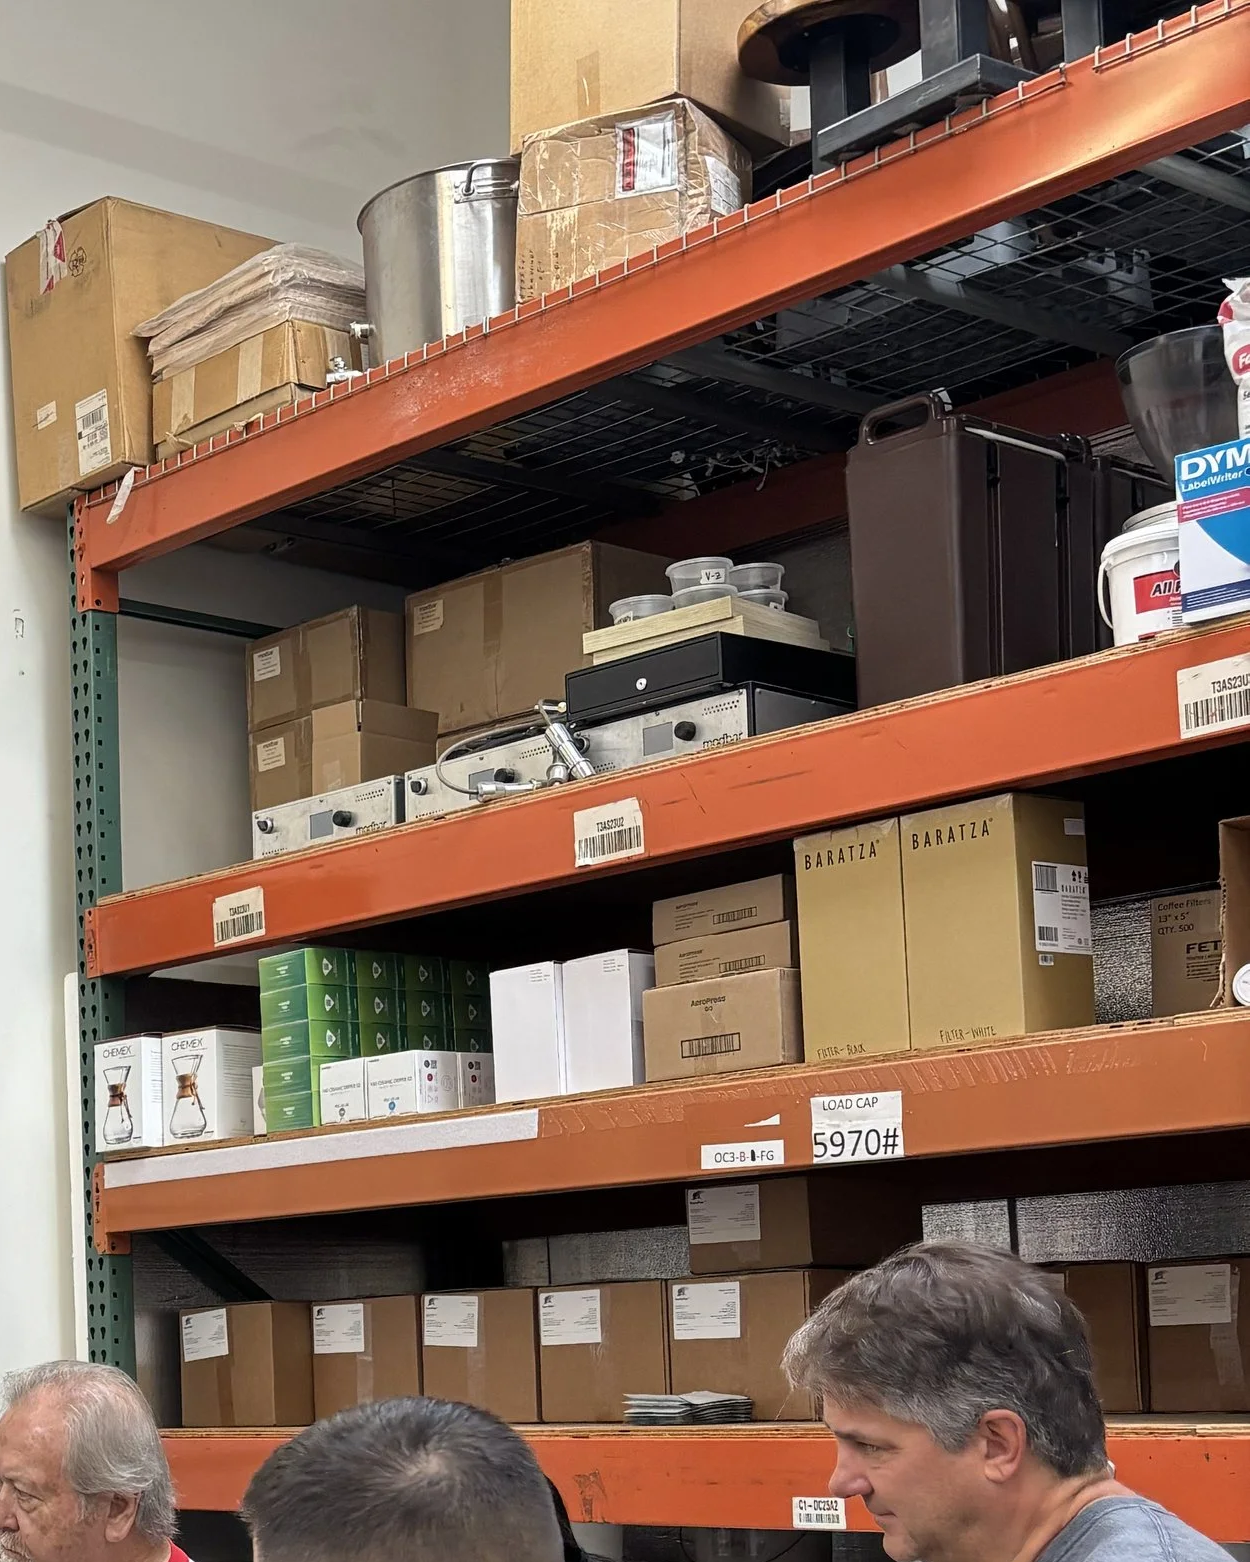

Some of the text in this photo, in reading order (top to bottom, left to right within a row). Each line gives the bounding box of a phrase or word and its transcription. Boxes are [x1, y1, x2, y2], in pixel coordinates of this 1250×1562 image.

[1181, 470, 1243, 493] LabelWriter
[1152, 580, 1173, 597] All
[596, 816, 625, 833] T3AS23U2
[912, 820, 990, 850] BARATZA
[804, 841, 877, 871] BARATZA
[1157, 902, 1184, 911] Coffee
[1178, 923, 1194, 933] 500
[102, 1045, 133, 1059] CHEMEX
[171, 1037, 204, 1052] CHEMEX
[822, 1096, 879, 1111] LOAD CAP
[813, 1127, 899, 1158] 5970#
